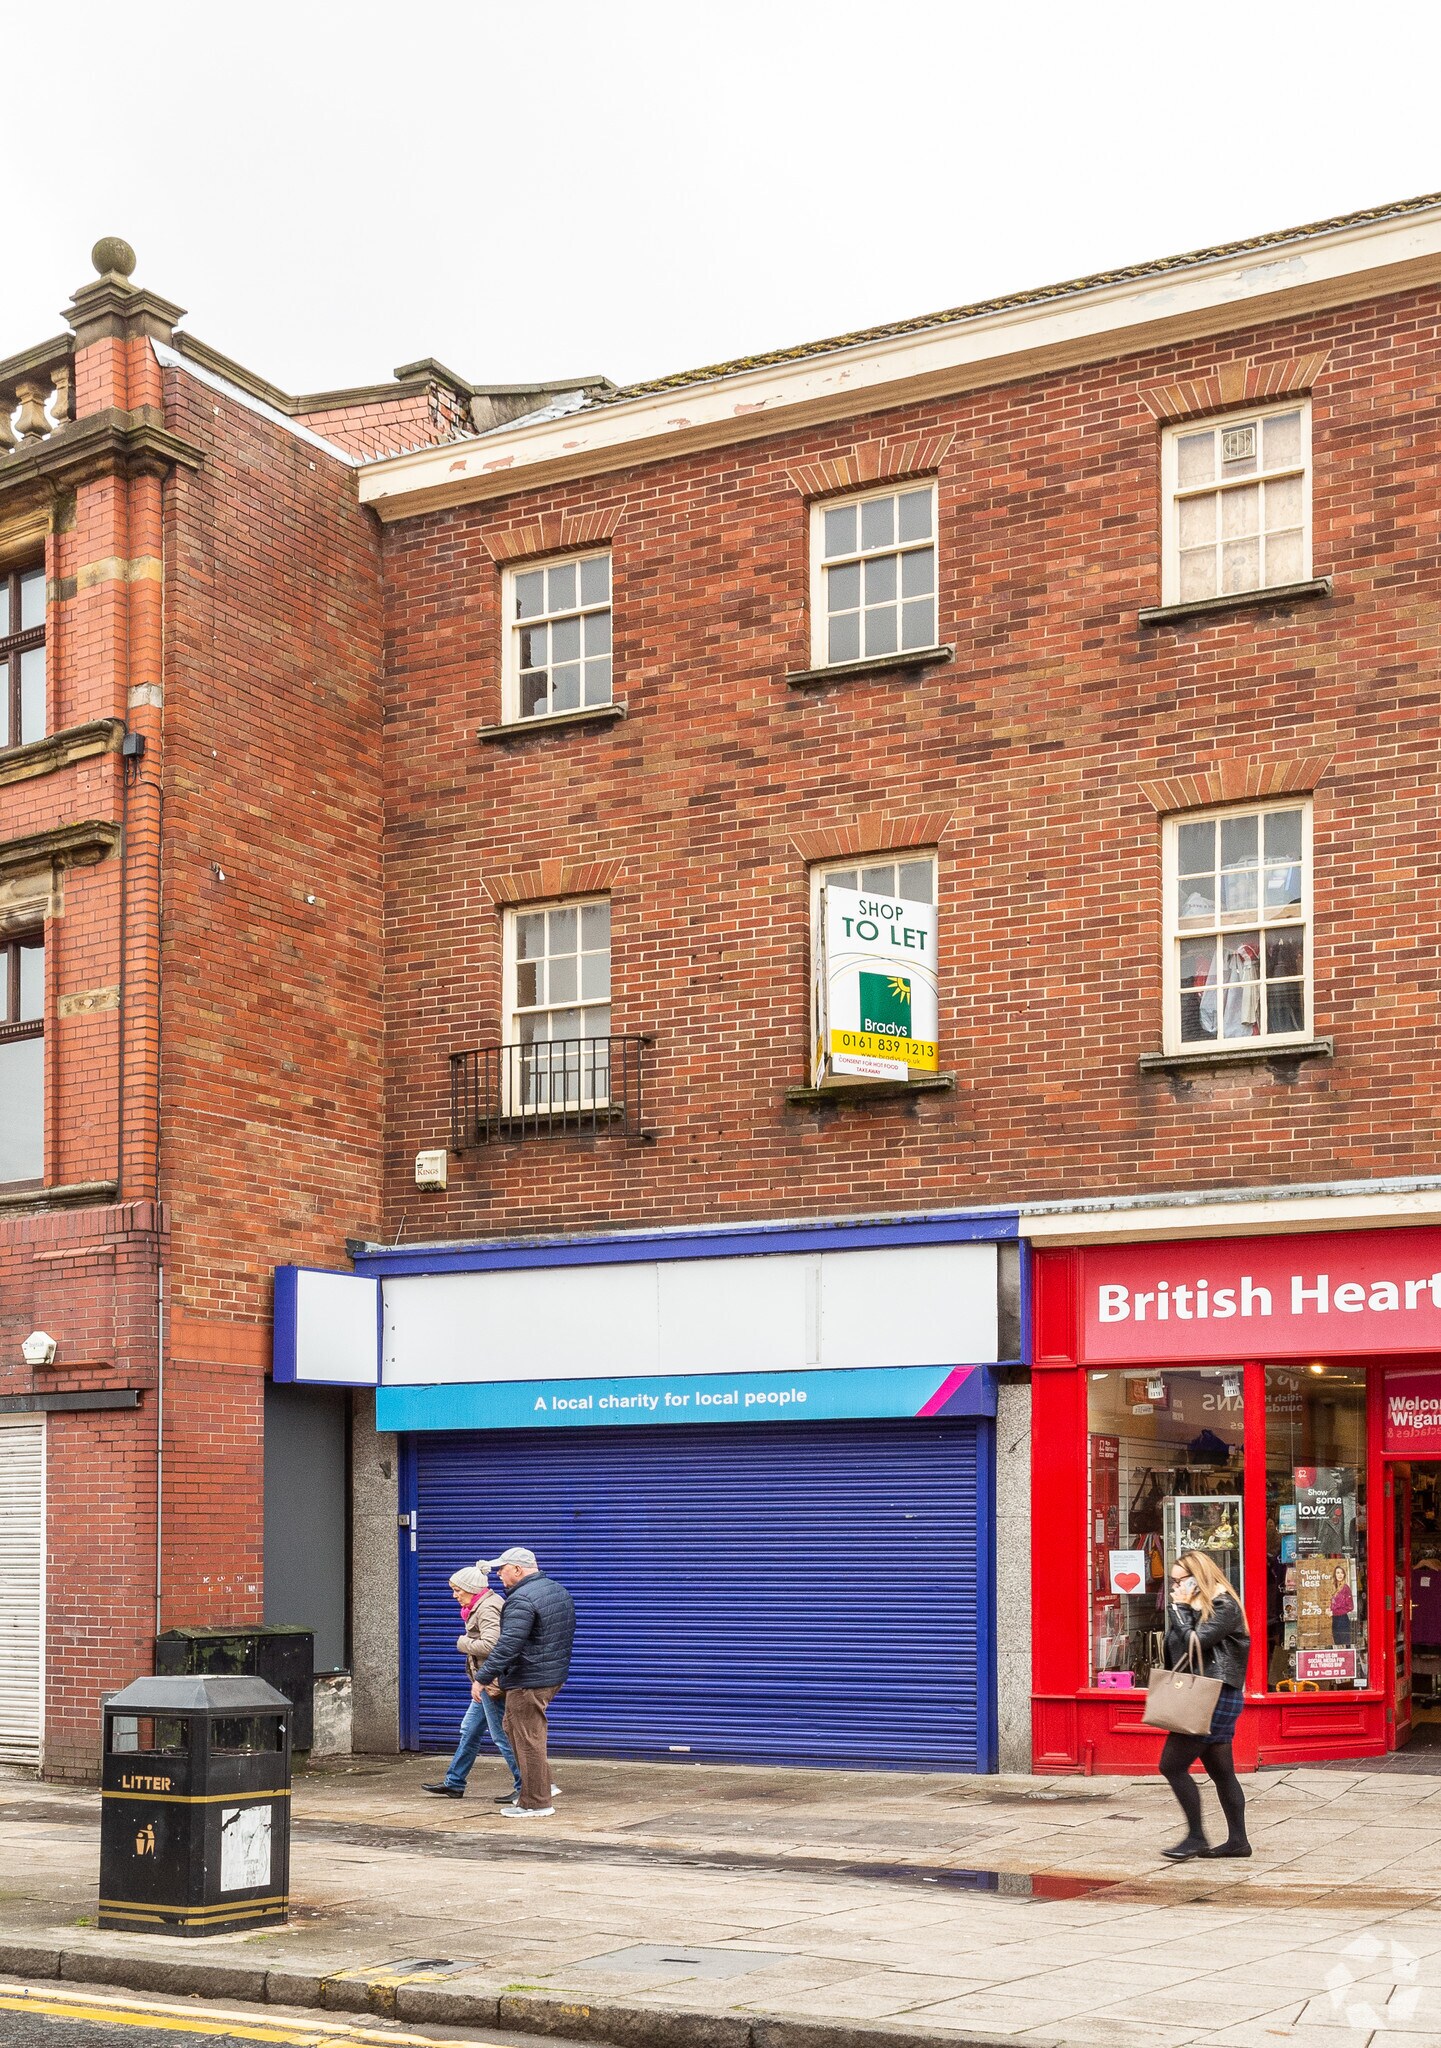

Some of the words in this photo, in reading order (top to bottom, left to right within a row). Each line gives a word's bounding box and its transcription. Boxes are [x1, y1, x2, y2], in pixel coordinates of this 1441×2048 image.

[859, 899, 903, 921] SHOP
[842, 917, 879, 941] TO
[890, 925, 928, 950] LET
[864, 1018, 908, 1037] Bradys
[842, 1034, 872, 1048] 0161
[878, 1039, 900, 1052] 839
[905, 1042, 934, 1057] 1213
[838, 1057, 862, 1065] CONSENT
[856, 1066, 881, 1074] TAKEAWAY
[1098, 1276, 1272, 1323] British
[1291, 1271, 1441, 1315] Heart
[534, 1396, 548, 1410] A
[552, 1395, 593, 1410] local
[598, 1394, 659, 1411] charity
[664, 1392, 691, 1406] for
[695, 1390, 738, 1405] local
[744, 1388, 807, 1407] people
[1389, 1396, 1441, 1411] Welco
[1391, 1411, 1441, 1429] Wigan
[1307, 1488, 1328, 1496] Show
[1298, 1502, 1326, 1515] love
[1301, 1578, 1320, 1587] less
[1301, 1608, 1322, 1616] £2.79
[122, 1774, 171, 1791] LITTER
